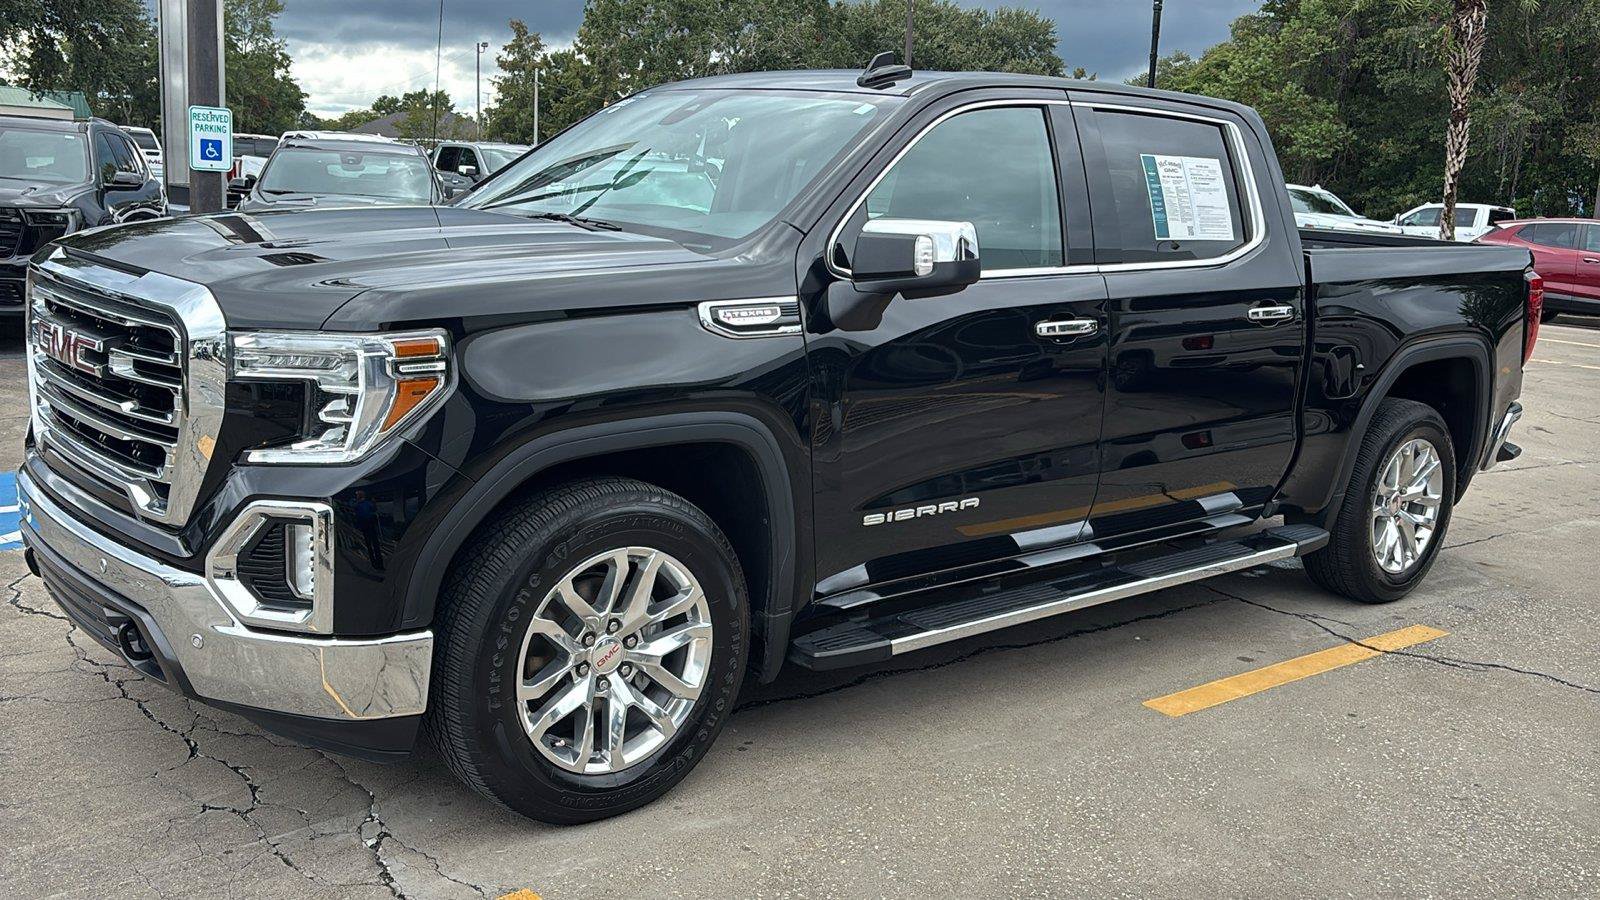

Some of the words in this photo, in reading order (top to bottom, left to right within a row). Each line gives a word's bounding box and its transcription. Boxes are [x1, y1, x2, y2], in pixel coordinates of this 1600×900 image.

[193, 112, 228, 123] RESERVED
[195, 123, 227, 134] PARKING
[732, 308, 773, 318] TEXAS
[38, 319, 103, 378] GMC
[862, 497, 980, 526] SIERRA
[596, 643, 620, 668] GMC
